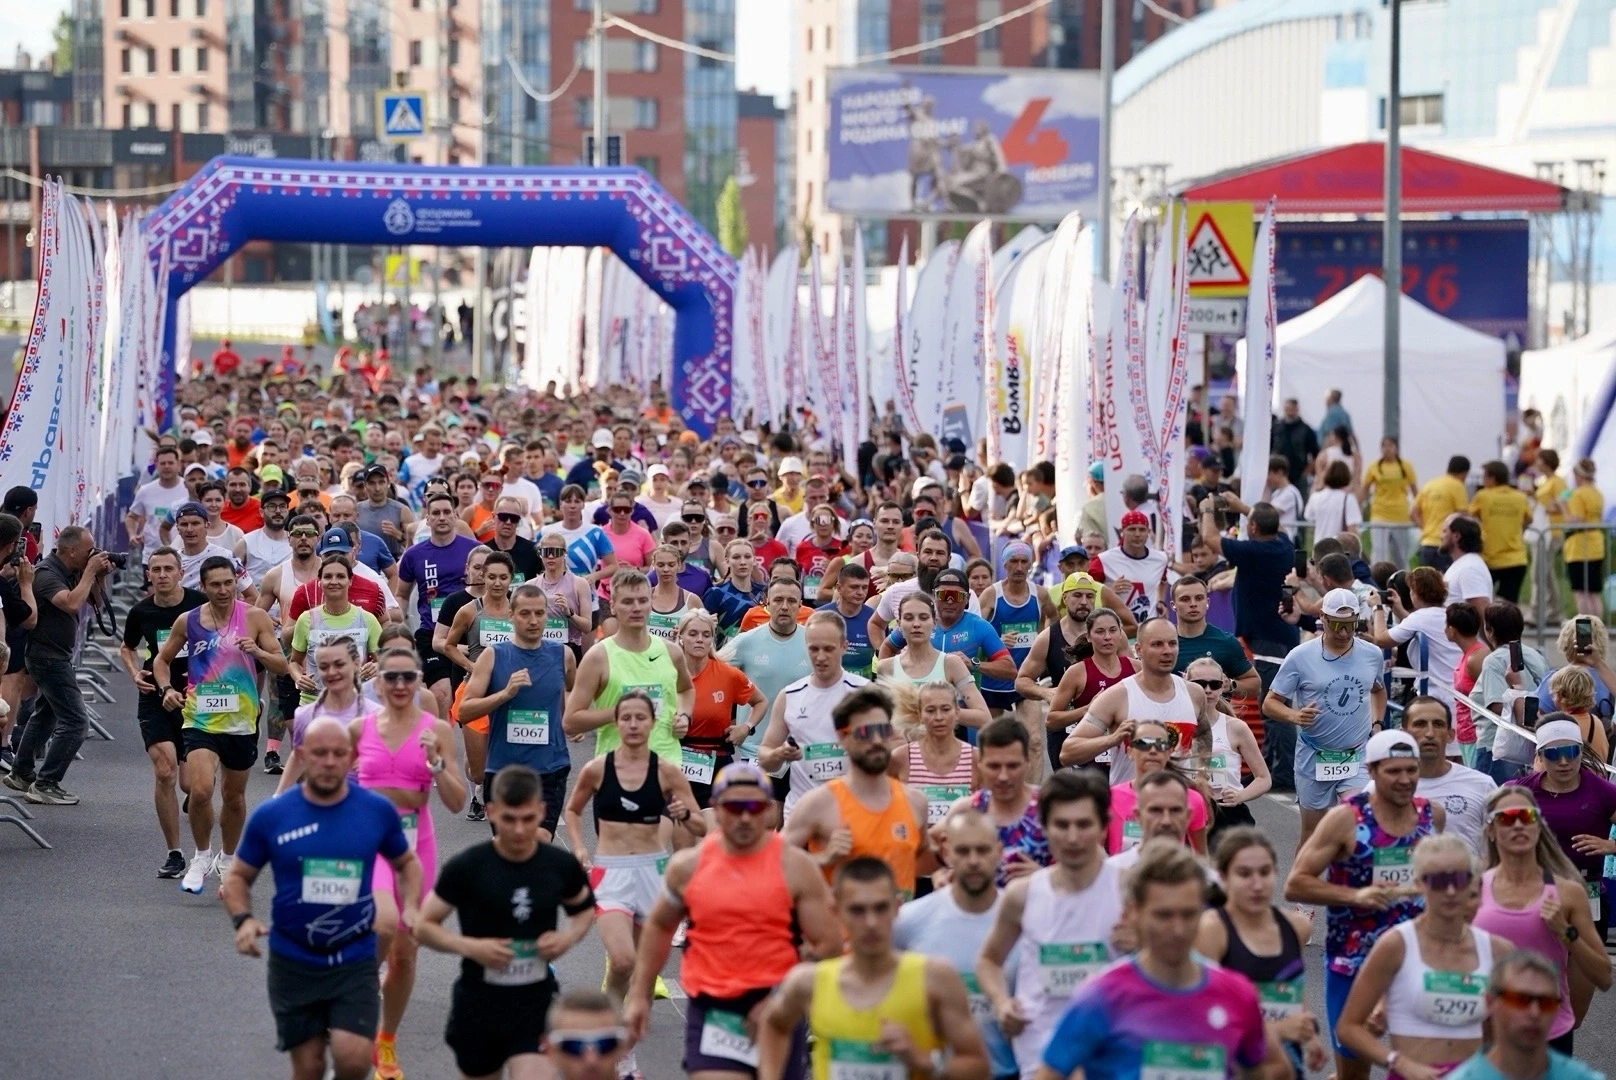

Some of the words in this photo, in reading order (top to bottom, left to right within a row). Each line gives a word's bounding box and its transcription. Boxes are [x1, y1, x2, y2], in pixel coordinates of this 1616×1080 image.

[1001, 97, 1069, 168] 4
[541, 630, 563, 639] 460
[1344, 675, 1364, 704] BIVIUM
[206, 698, 228, 708] 5211
[712, 691, 725, 704] 10
[513, 727, 544, 738] 5067
[813, 760, 842, 774] 5154
[1324, 765, 1350, 776] 5159
[1380, 868, 1414, 883] 503
[311, 880, 350, 897] 5106
[1433, 998, 1479, 1016] 5297
